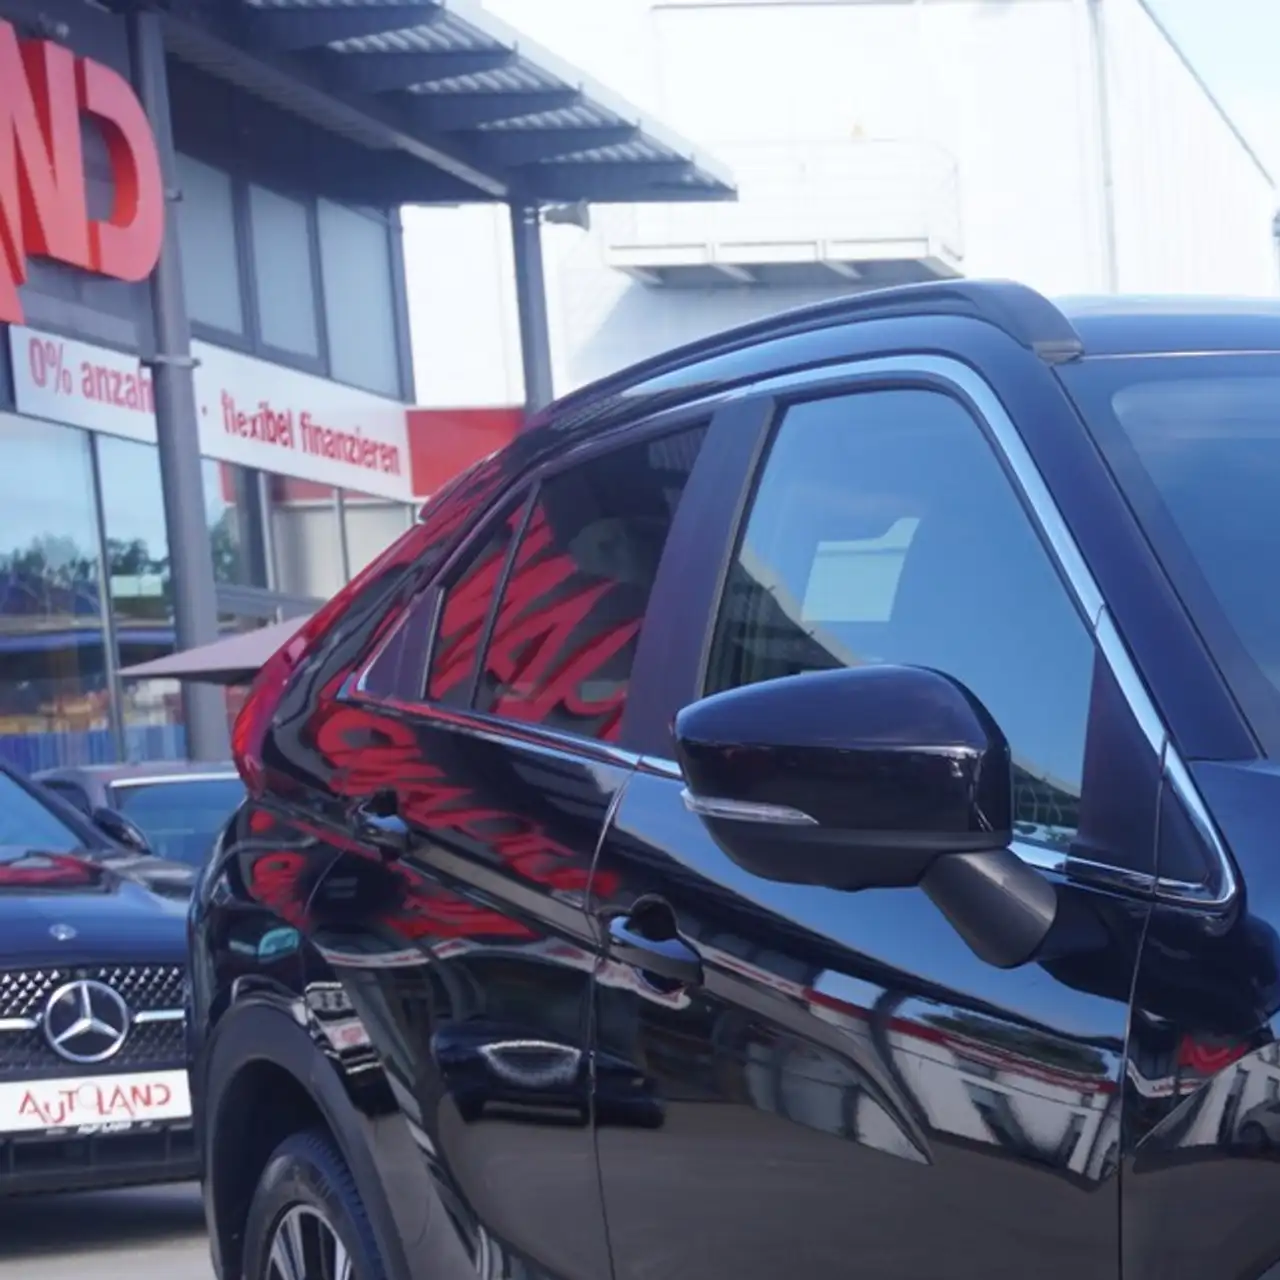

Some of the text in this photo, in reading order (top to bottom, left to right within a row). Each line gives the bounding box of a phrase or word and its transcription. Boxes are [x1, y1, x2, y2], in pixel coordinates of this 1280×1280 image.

[0, 17, 164, 323] ND
[29, 337, 72, 395] 0%
[222, 388, 295, 449] flexibel
[299, 411, 401, 476] finanzieren
[18, 1081, 172, 1125] AUTOLAND
